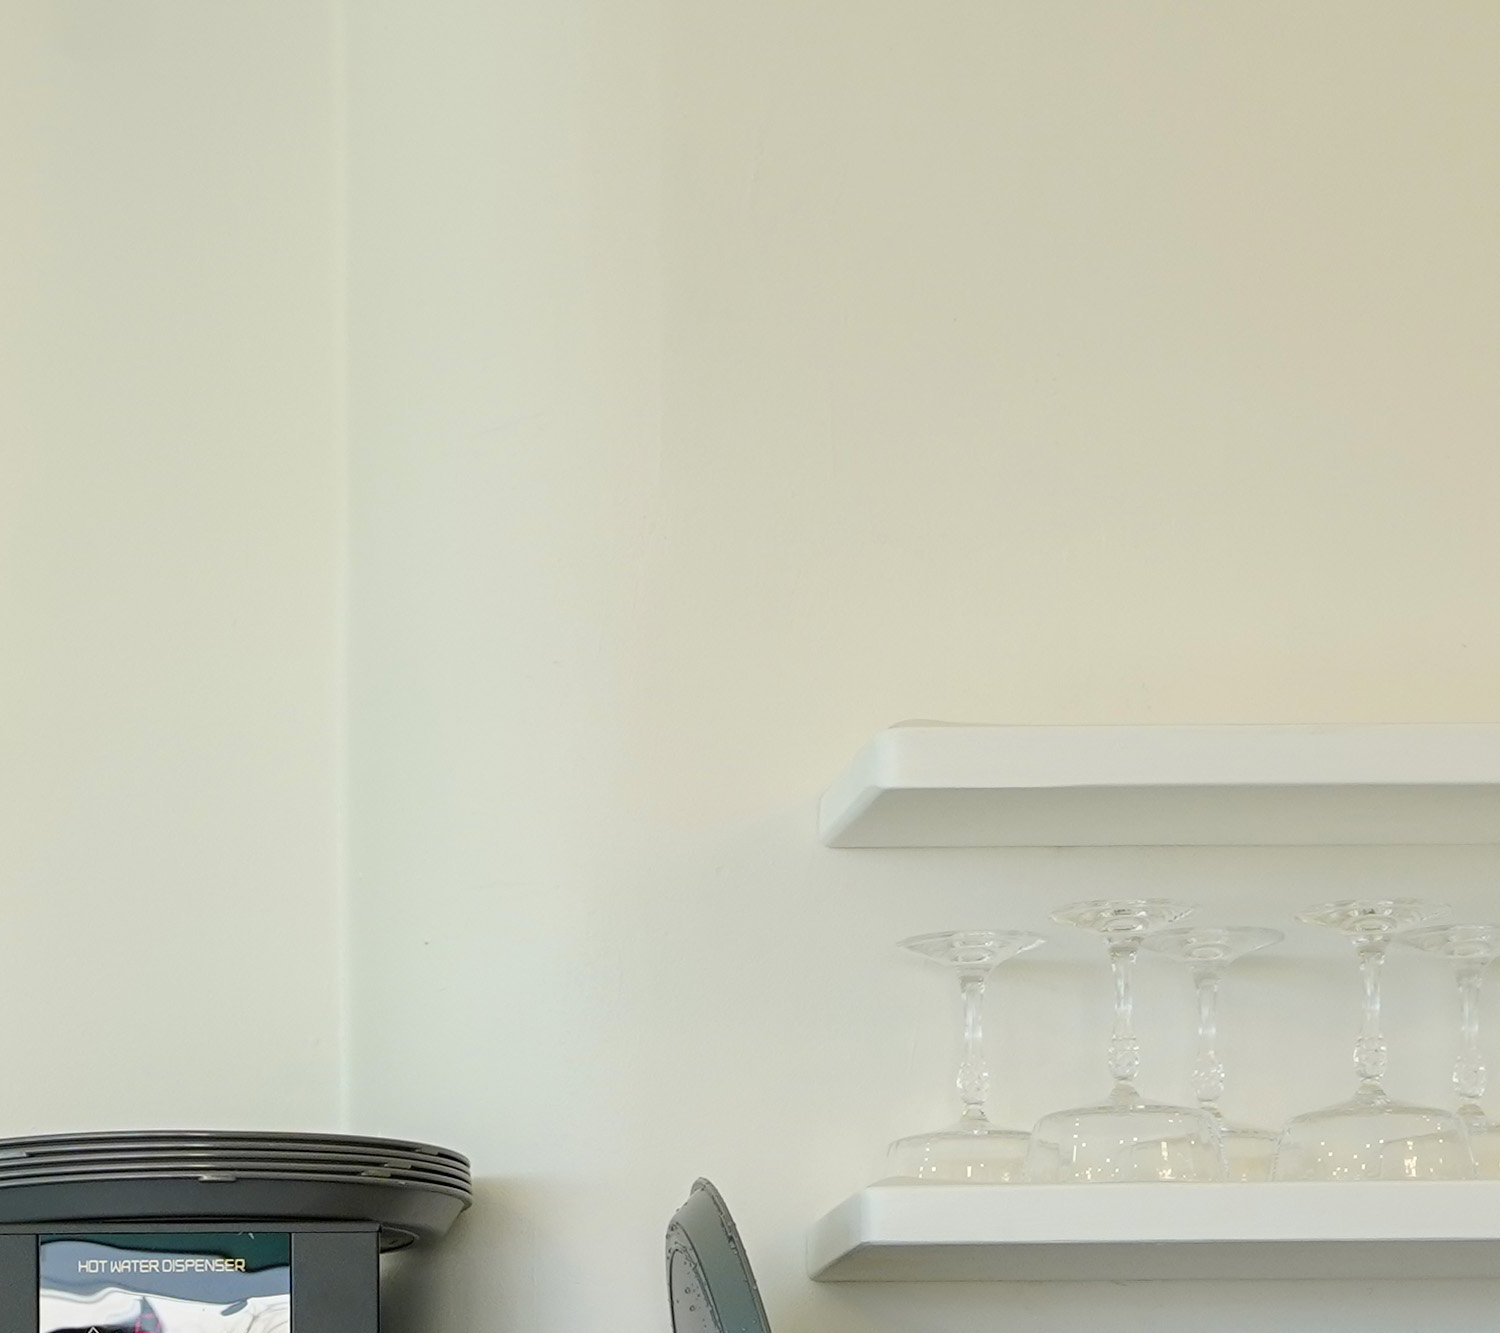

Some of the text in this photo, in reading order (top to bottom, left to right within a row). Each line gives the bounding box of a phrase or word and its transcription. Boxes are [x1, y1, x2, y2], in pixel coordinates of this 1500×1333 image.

[78, 1258, 246, 1273] HOT WATER DISPENSER
